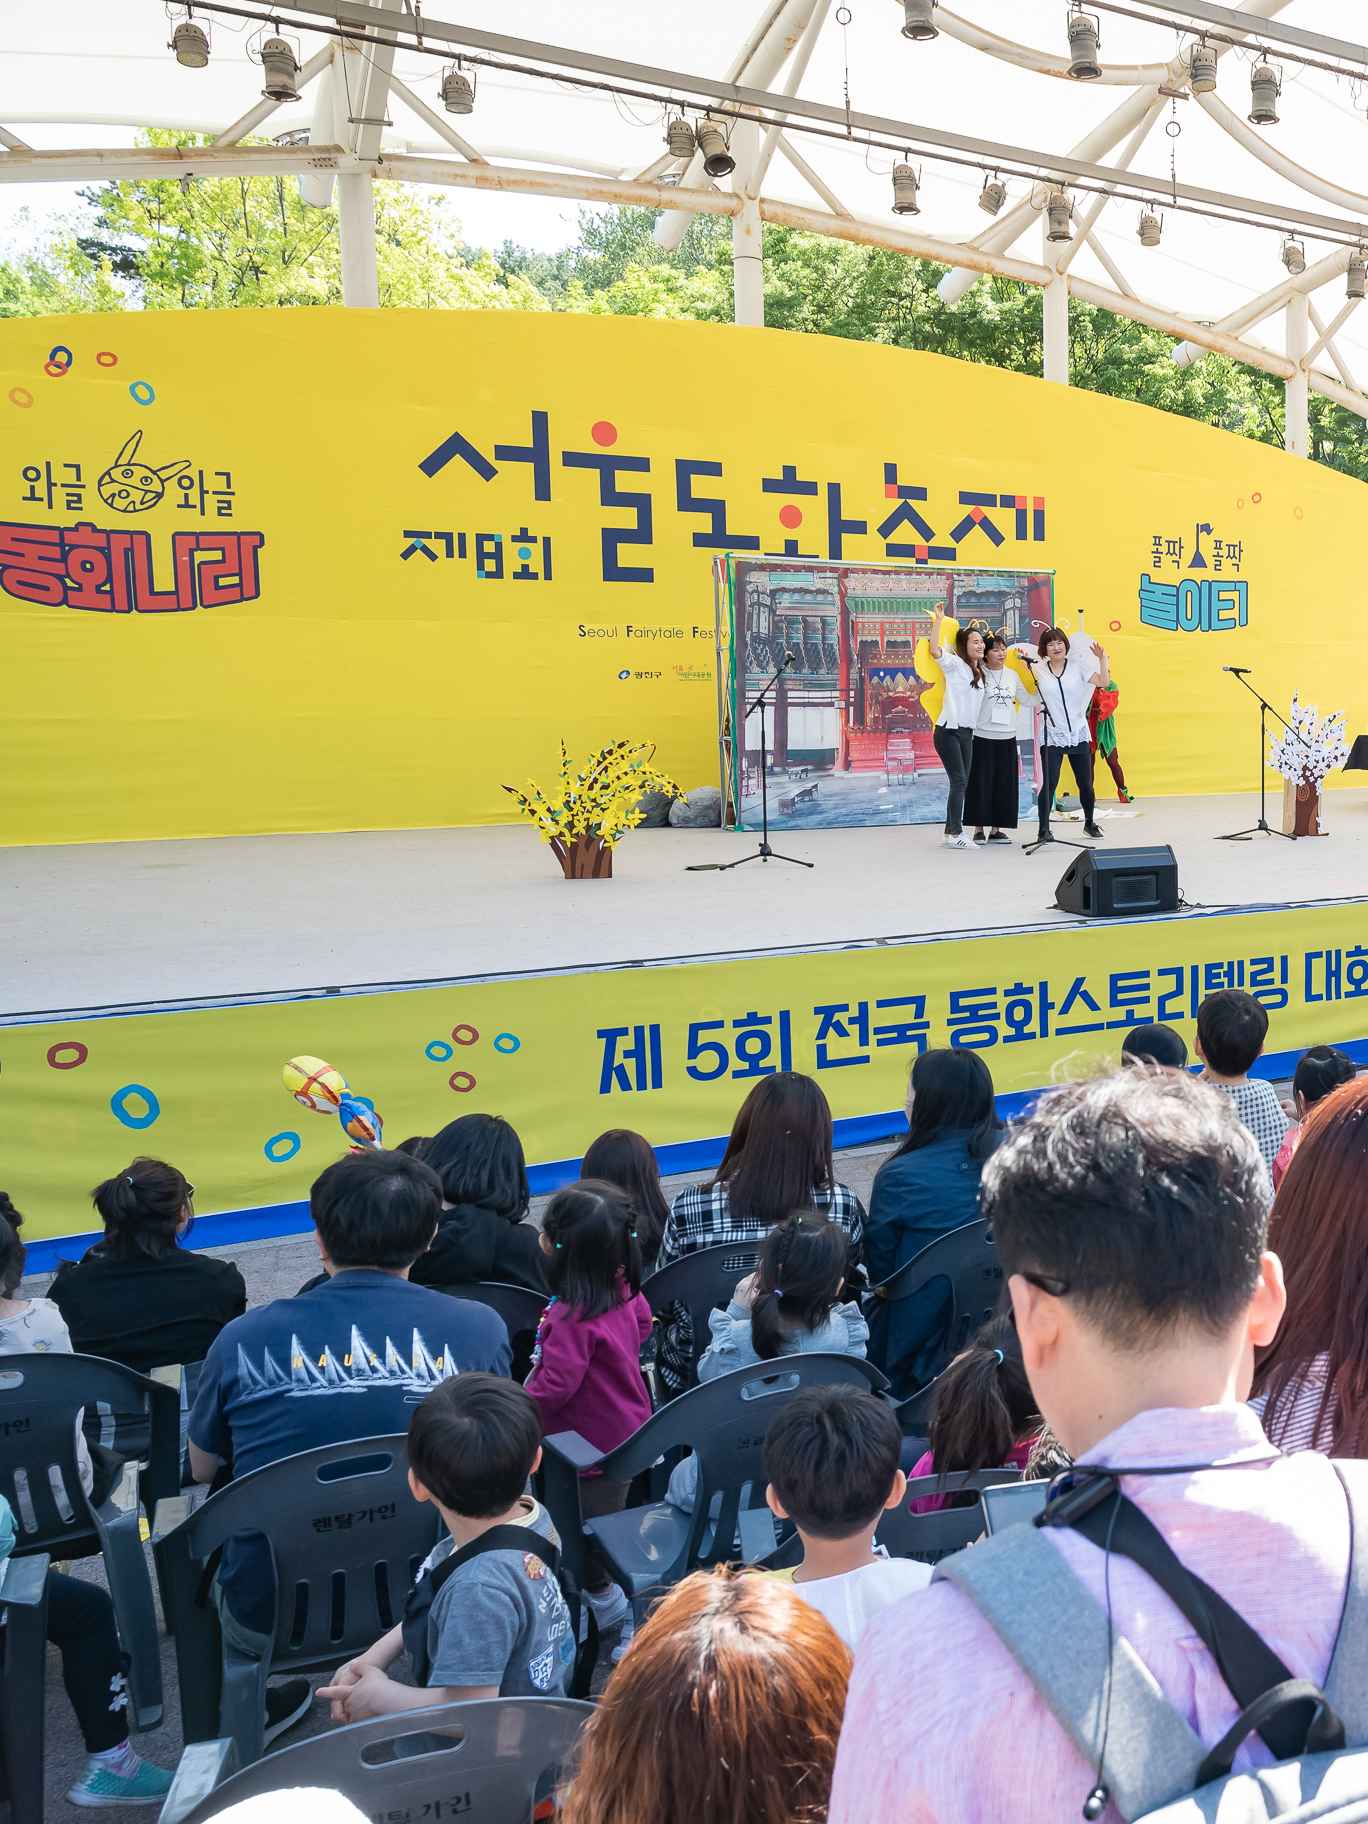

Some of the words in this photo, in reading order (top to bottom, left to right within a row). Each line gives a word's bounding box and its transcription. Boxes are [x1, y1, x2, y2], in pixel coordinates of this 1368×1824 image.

[22, 461, 87, 511] 와글
[176, 469, 236, 517] 와글
[399, 526, 553, 582] 제8회
[1151, 535, 1184, 569] 폴짝
[1212, 539, 1243, 572] 폴짝
[1138, 573, 1248, 632] 놀이터
[578, 624, 618, 638] Seoul
[626, 625, 684, 640] Fairytale
[634, 671, 662, 679] 광진구
[596, 1023, 663, 1095] 제
[686, 1009, 792, 1082] 5회
[813, 994, 932, 1070] 전국
[946, 954, 1289, 1050] 동화스토리텔링
[293, 1353, 444, 1370] NAUTICA
[312, 1502, 396, 1533] 렌탈가인
